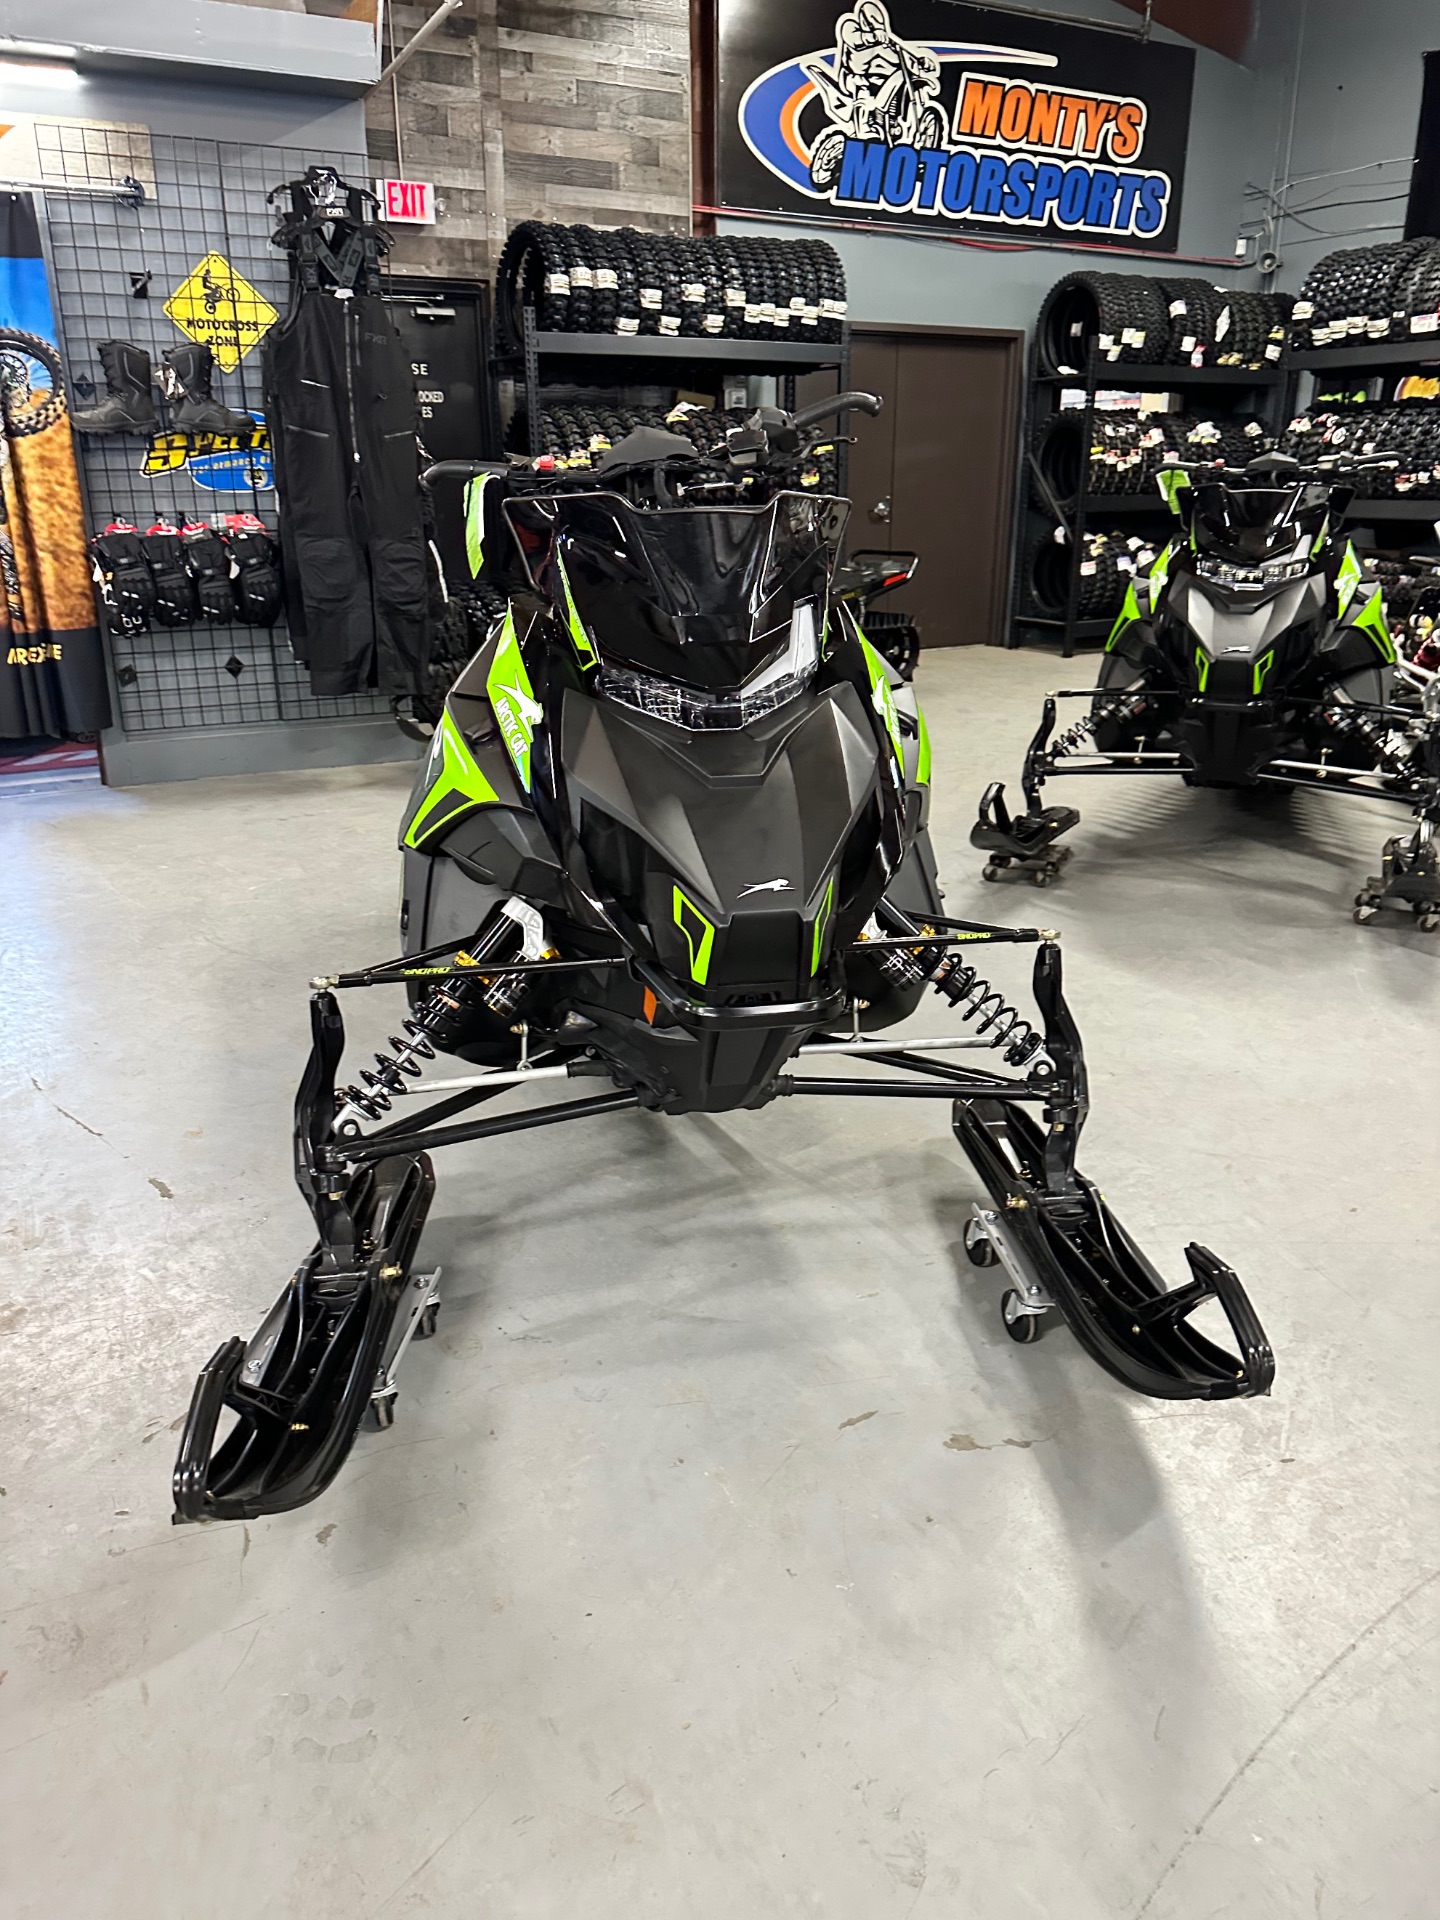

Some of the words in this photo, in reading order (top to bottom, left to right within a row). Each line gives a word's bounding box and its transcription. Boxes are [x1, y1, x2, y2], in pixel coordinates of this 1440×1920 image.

[957, 79, 1144, 157] MONTY'S
[387, 181, 426, 218] EXIT
[836, 139, 1167, 234] MOTORSPORTS
[186, 318, 259, 331] MOTOCROSS
[207, 335, 239, 346] ZONE
[495, 696, 519, 738] ARCTIC
[510, 732, 529, 758] CAT
